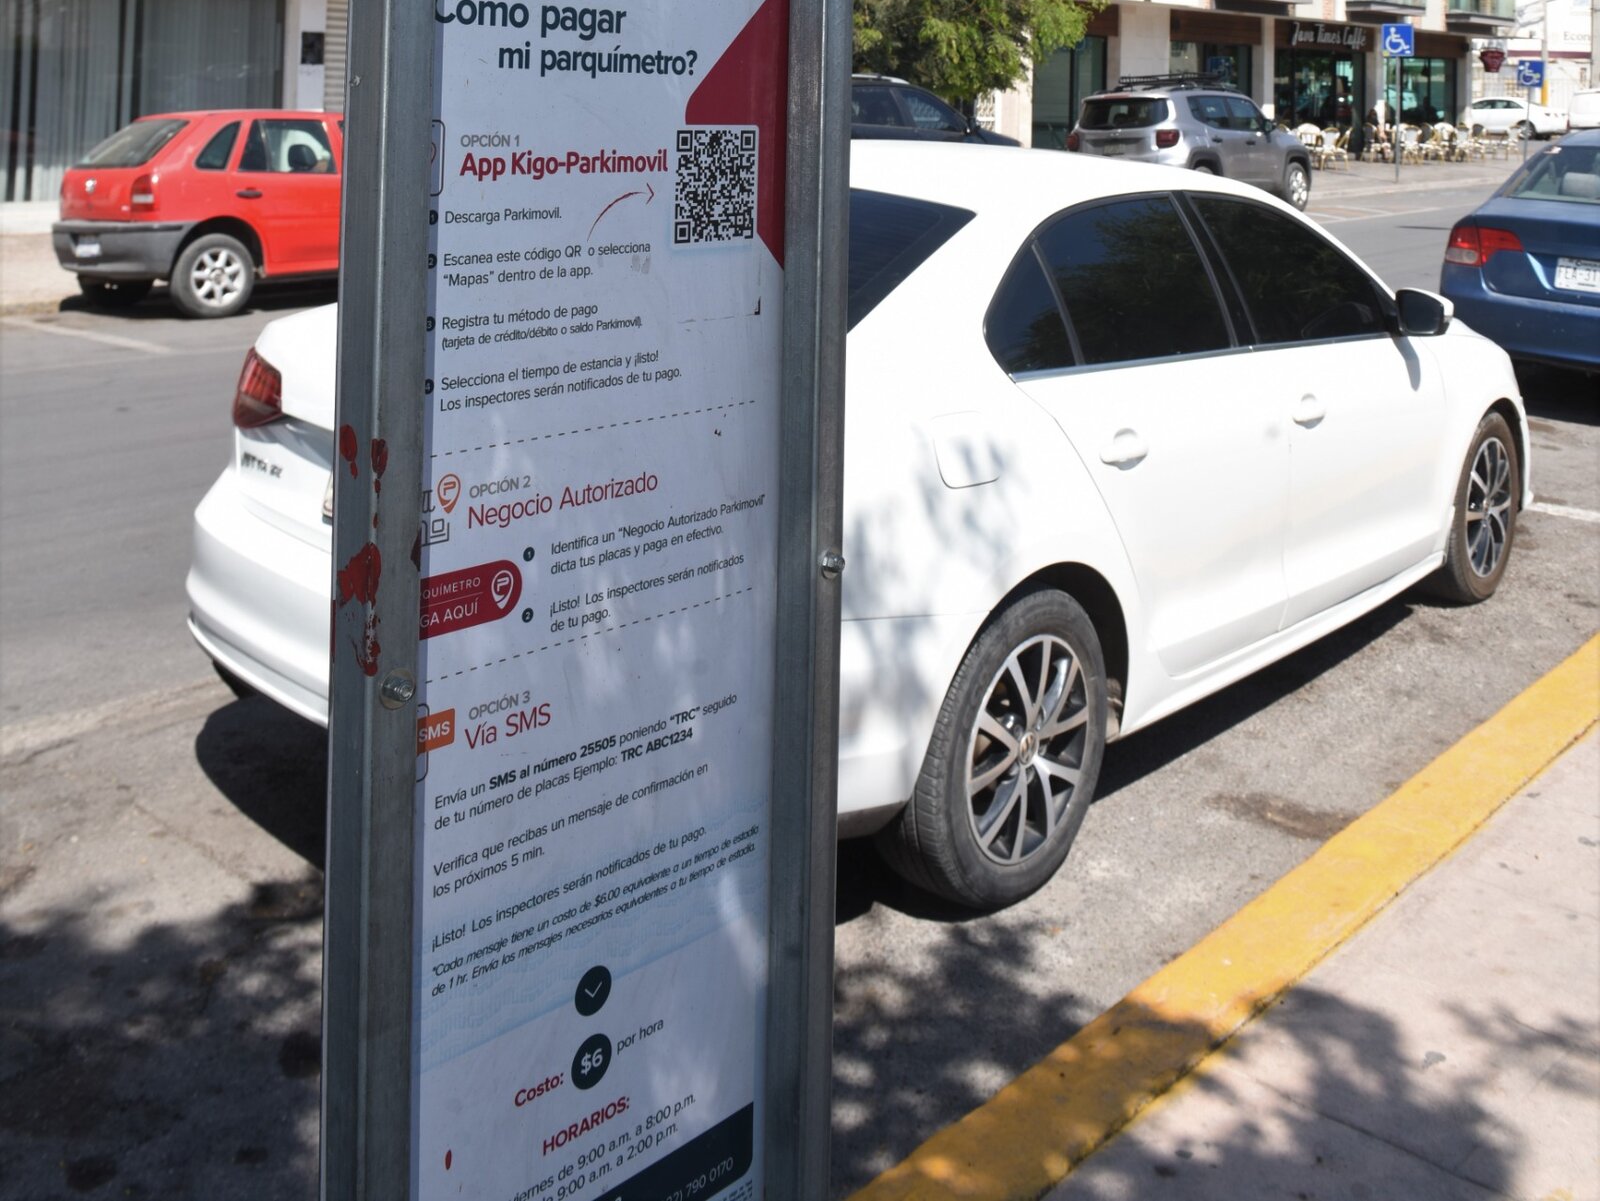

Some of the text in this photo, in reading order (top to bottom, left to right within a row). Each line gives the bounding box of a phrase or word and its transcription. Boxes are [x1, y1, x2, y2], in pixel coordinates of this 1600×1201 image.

[541, 4, 627, 41] pagar
[499, 41, 698, 79] mi parquímetro?
[461, 130, 519, 148] OPCIÓN 1
[460, 149, 668, 182] App Kigo-Parkimovil
[445, 206, 562, 225] Descarga Parkimovil.
[444, 253, 492, 267] Escanea
[497, 250, 520, 263] este
[524, 247, 561, 263] código
[565, 245, 581, 258] QR
[598, 242, 650, 256] selecciona
[498, 270, 536, 283] dentro
[539, 267, 554, 280] de
[558, 266, 566, 278] la
[570, 266, 593, 280] app.
[442, 335, 475, 351] (tarjeta
[478, 332, 491, 345] de
[494, 326, 558, 343] crédito/débito
[570, 321, 593, 334] saldo
[443, 305, 598, 332] Registra tu método de pago
[441, 368, 682, 411] Los inspectores serán notificados de tu pago.
[442, 372, 504, 391] Selecciona
[508, 368, 518, 382] el
[522, 366, 559, 380] tiempo
[563, 361, 576, 374] de
[580, 357, 622, 371] estancia
[469, 475, 530, 499] OPCIÓN 2
[469, 472, 657, 529] Negocio Autorizado
[552, 535, 598, 556] Identifica
[602, 531, 615, 544] un
[667, 508, 717, 529] Autorizado
[551, 559, 576, 575] dicta
[580, 555, 595, 568] tus
[599, 547, 631, 566] placas
[643, 538, 667, 555] paga
[671, 534, 683, 546] en
[686, 525, 722, 542] efectivo.
[421, 577, 481, 599] QUÍMETRO
[550, 554, 744, 618] ¡Listo! Los inspectores serán notificados
[443, 597, 480, 622] AQUÍ
[551, 608, 611, 633] de tu pago.
[469, 690, 530, 721] OPCIÓN 3
[419, 721, 450, 742] SMS
[465, 703, 550, 750] Vía SMS
[435, 790, 466, 809] Envía
[471, 784, 485, 797] un
[489, 769, 516, 790] SMS
[520, 765, 530, 780] al
[534, 751, 577, 774] número
[580, 734, 616, 758] 25505
[620, 720, 666, 747] poniendo
[703, 694, 736, 715] seguido
[435, 727, 693, 830] de tu número de placas Ejemplo: TRC ABC1234
[434, 764, 707, 876] Verifica que recibas un mensaje de confirmación en
[432, 827, 706, 952] ¡Listo! Los inspectores serán notificados de tu pago.
[434, 846, 545, 898] los próximos 5 min.
[617, 1019, 663, 1055] por hora
[580, 1048, 603, 1076] $6
[515, 1073, 563, 1107] Costo:
[543, 1096, 629, 1156] HORARIOS:
[686, 1177, 706, 1199] 790
[709, 1156, 734, 1180] 0170
